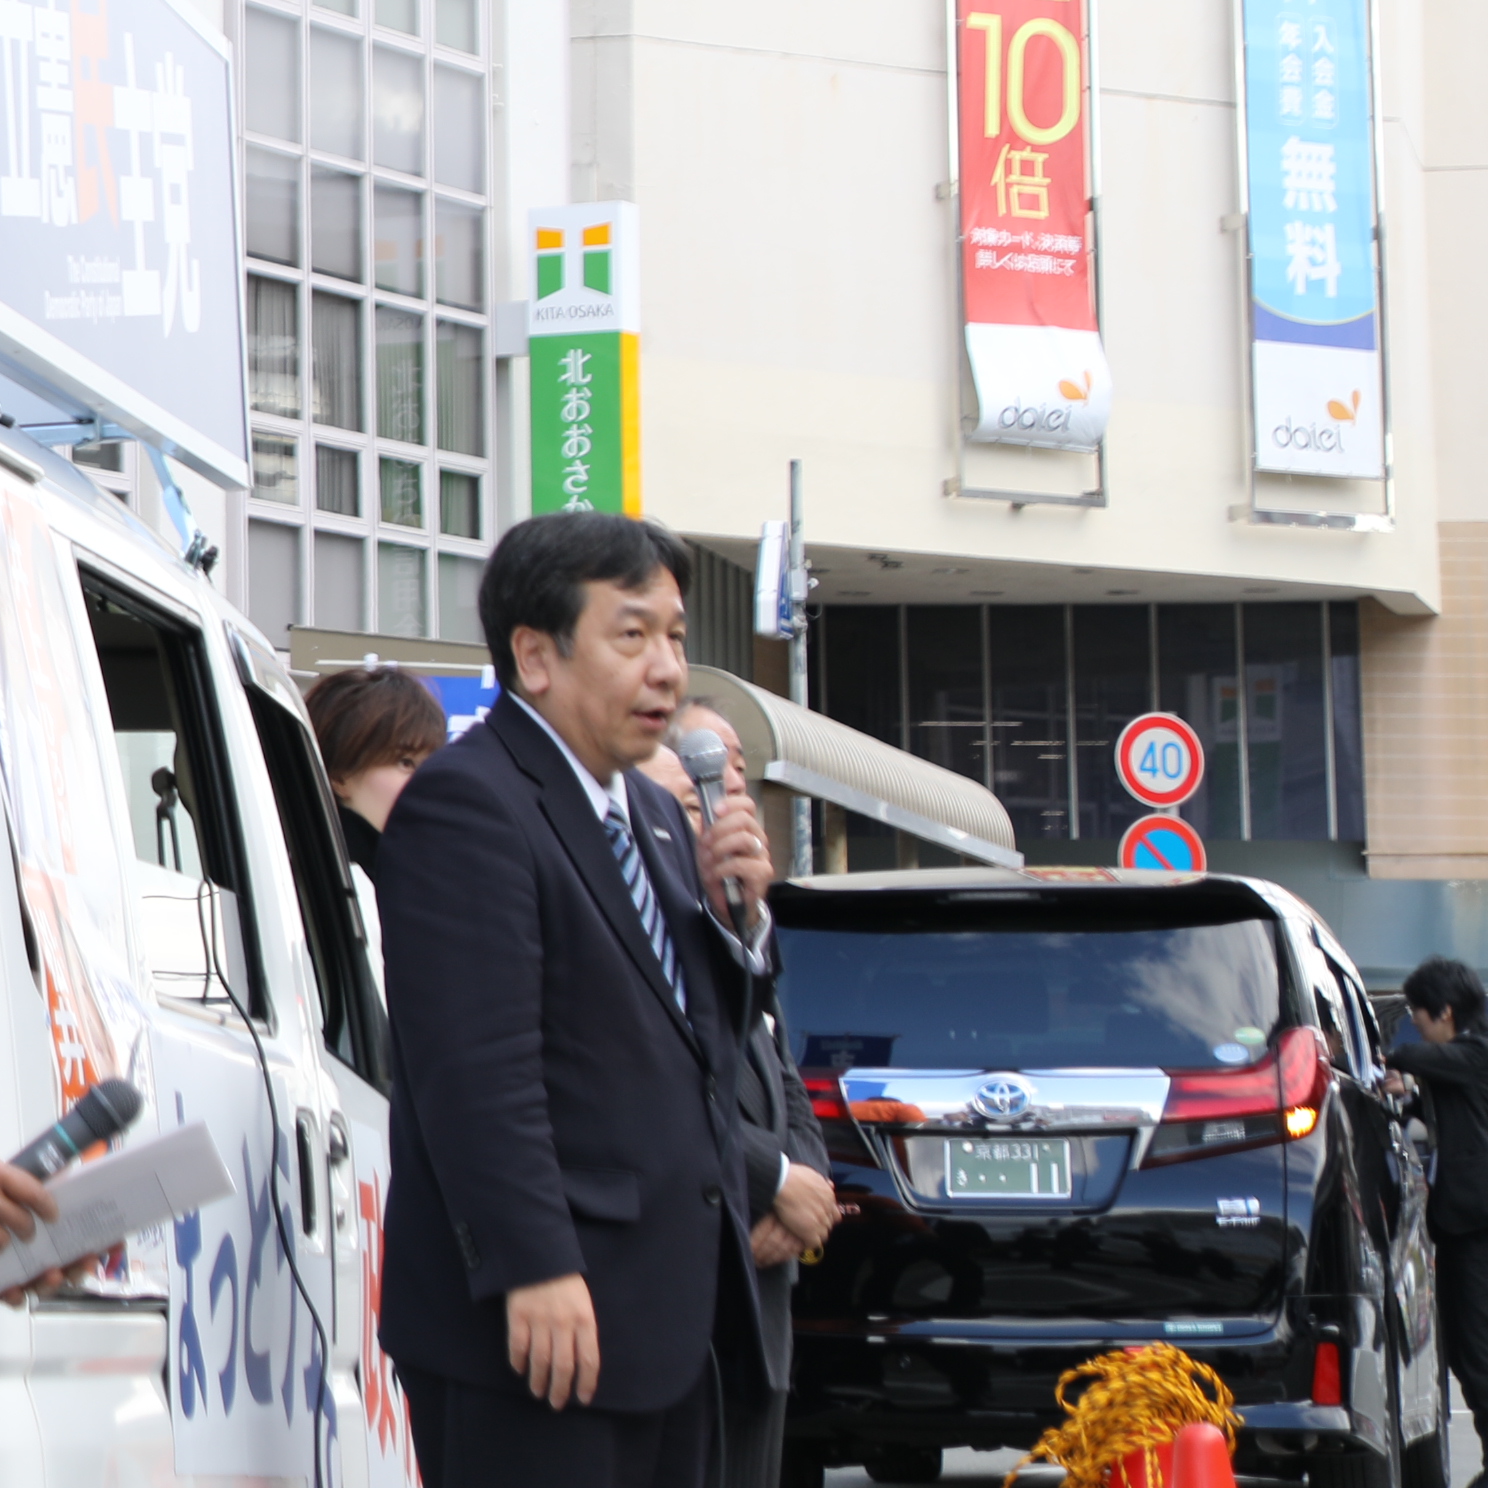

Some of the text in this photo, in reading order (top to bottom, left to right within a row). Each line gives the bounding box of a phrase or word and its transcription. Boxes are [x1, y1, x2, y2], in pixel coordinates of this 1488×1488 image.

[964, 11, 1081, 146] 10
[1278, 18, 1304, 117] 年会費
[1310, 22, 1336, 120] 入会金
[990, 143, 1051, 220] 倍
[1279, 134, 1341, 298] 無料
[535, 302, 616, 321] KITA OSAKA
[997, 395, 1073, 434] daiei
[1270, 415, 1345, 454] daiei
[1139, 740, 1184, 780] 40
